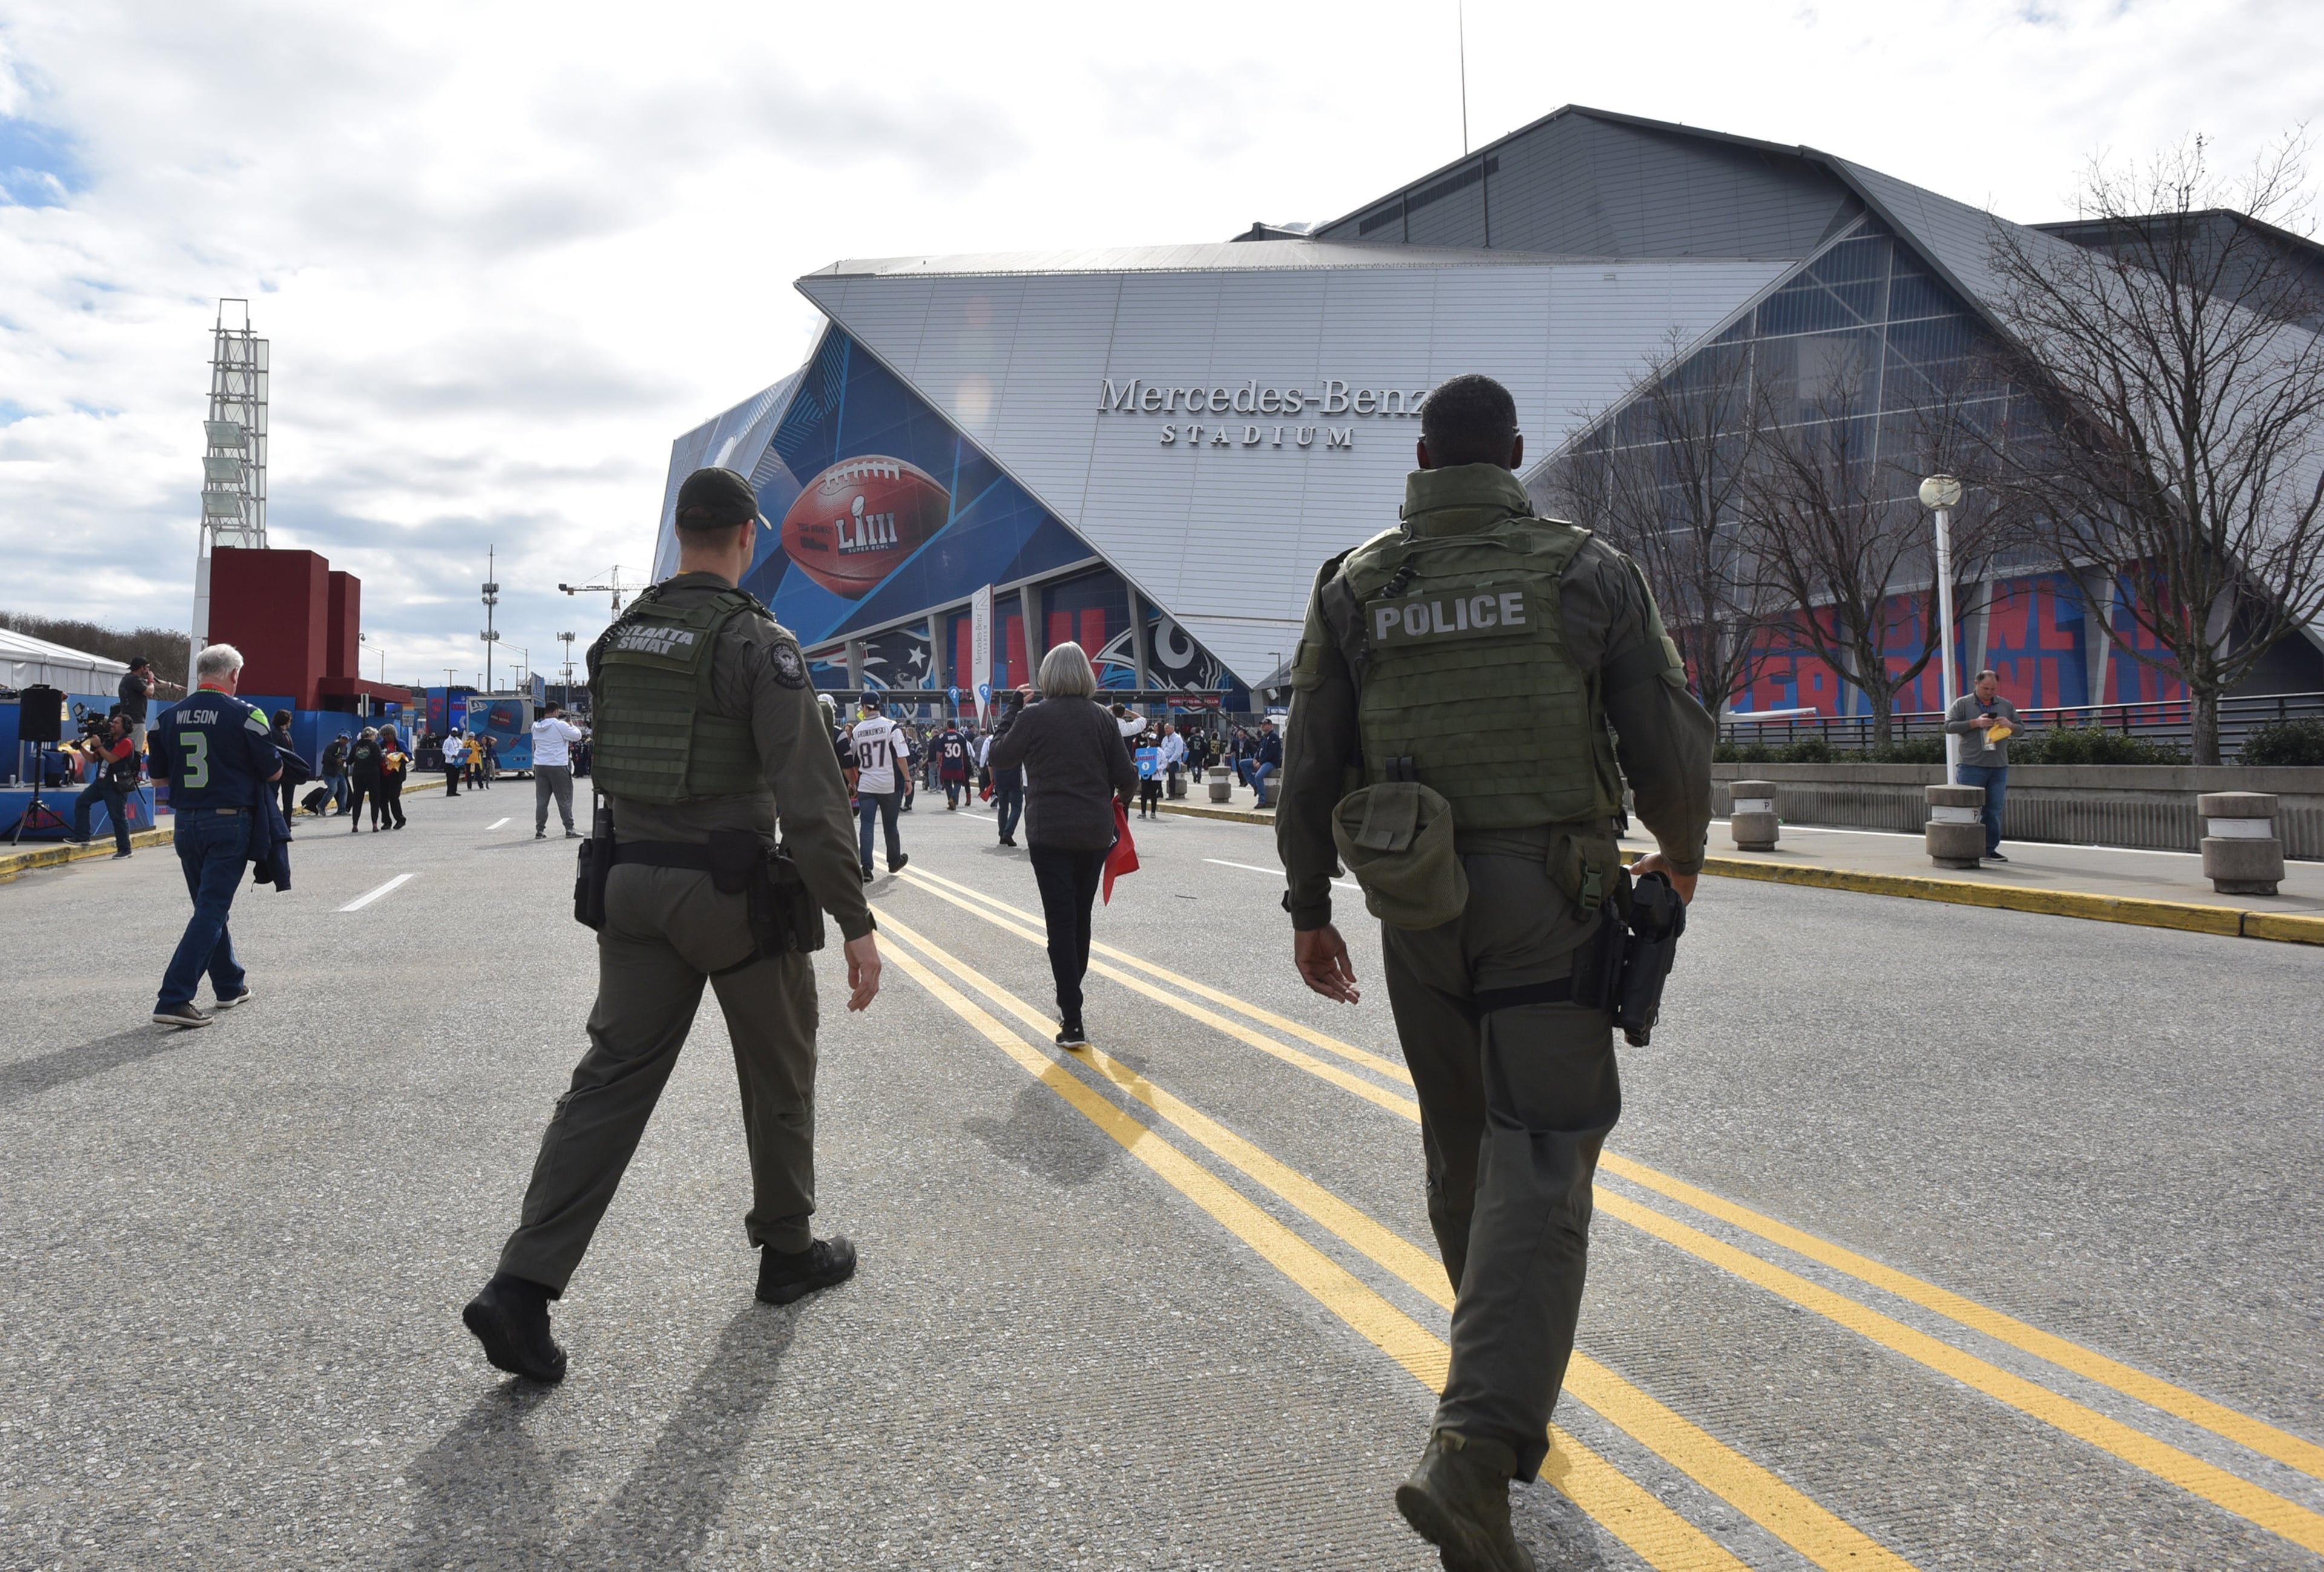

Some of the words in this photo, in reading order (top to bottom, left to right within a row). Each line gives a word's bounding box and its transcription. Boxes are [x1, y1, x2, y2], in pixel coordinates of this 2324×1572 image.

[1096, 378, 1433, 416] Mercedes-Benz
[1160, 424, 1354, 448] STADIUM
[1375, 592, 1526, 640] POLICE
[617, 637, 675, 655] SWAT
[176, 709, 218, 725] WILSON
[858, 727, 886, 738] GRONKOWSKI
[859, 739, 886, 769] 87
[944, 742, 961, 758] 30
[1193, 741, 1201, 750] 12
[1210, 744, 1220, 755] 50
[180, 732, 208, 788] 3
